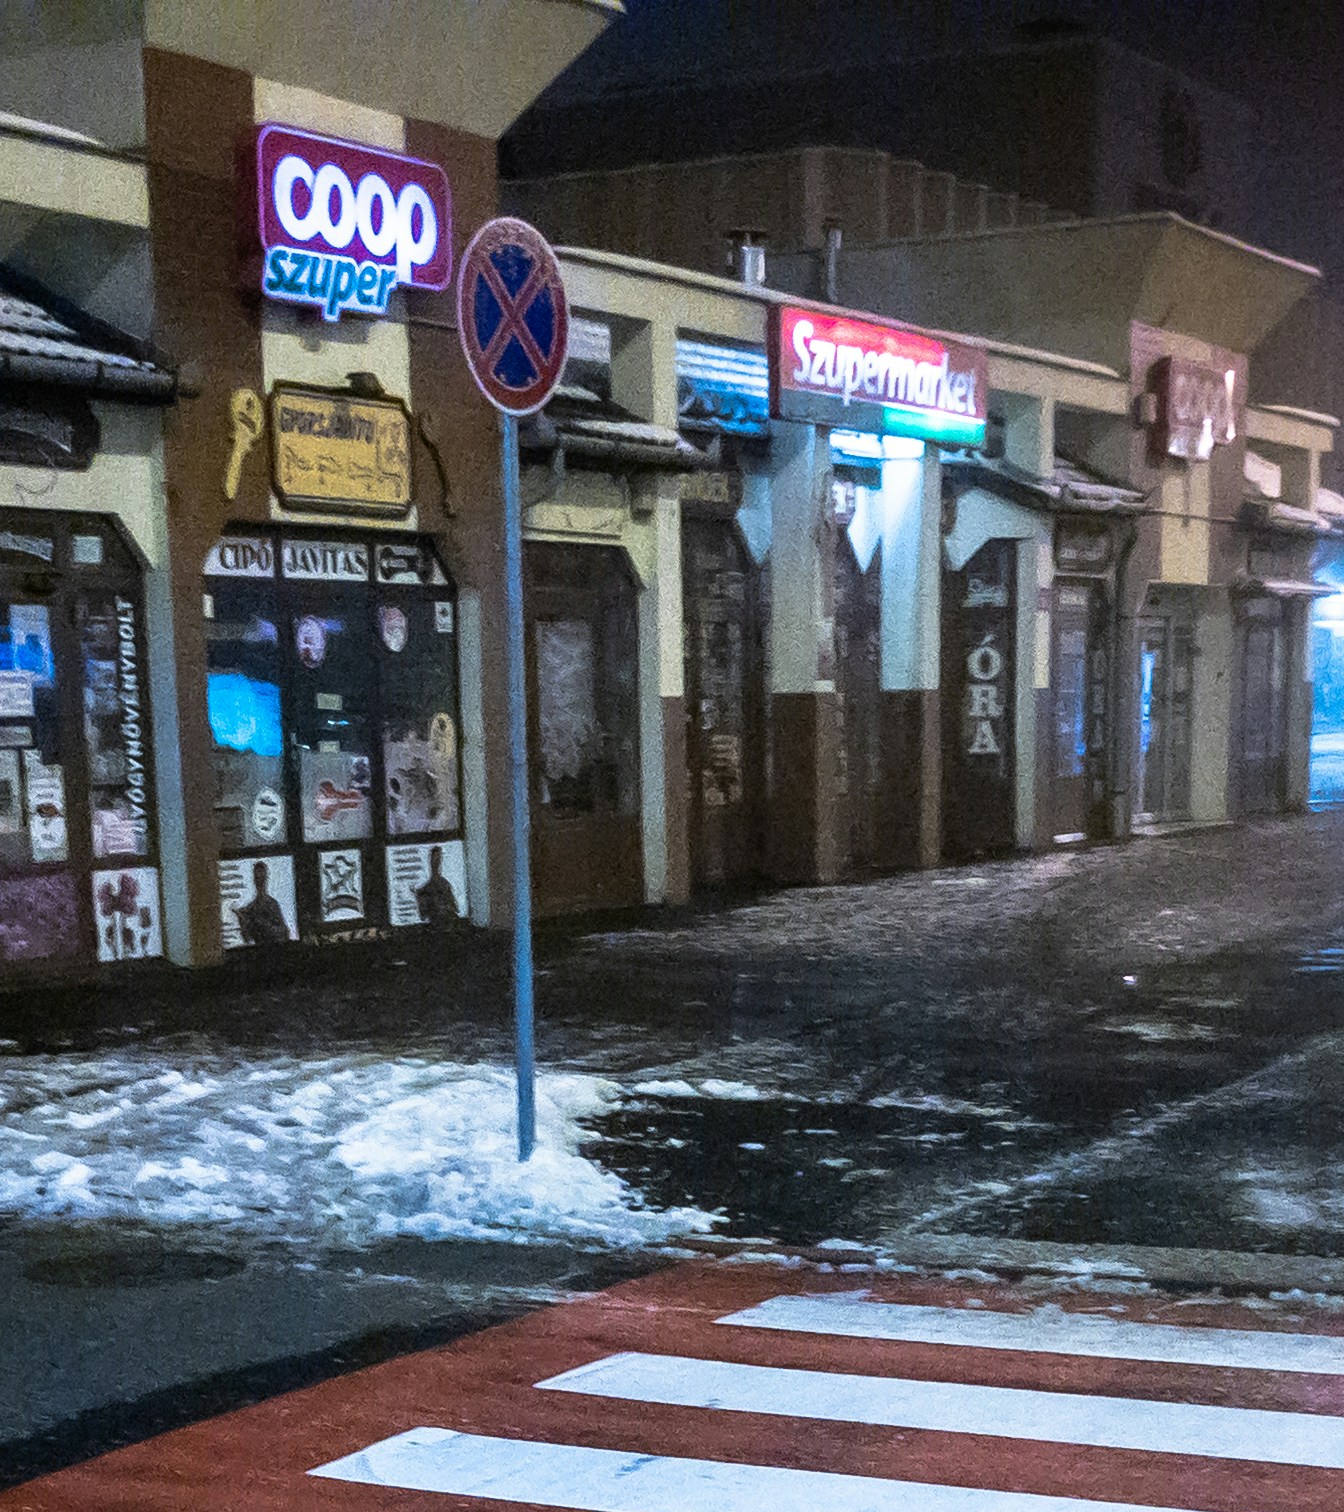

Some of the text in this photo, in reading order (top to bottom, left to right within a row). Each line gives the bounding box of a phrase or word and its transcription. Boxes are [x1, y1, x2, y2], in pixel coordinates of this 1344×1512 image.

[272, 153, 438, 285] coop
[265, 249, 398, 315] szuper
[791, 318, 977, 416] Szupermarket
[966, 634, 1003, 755] ÓRA
